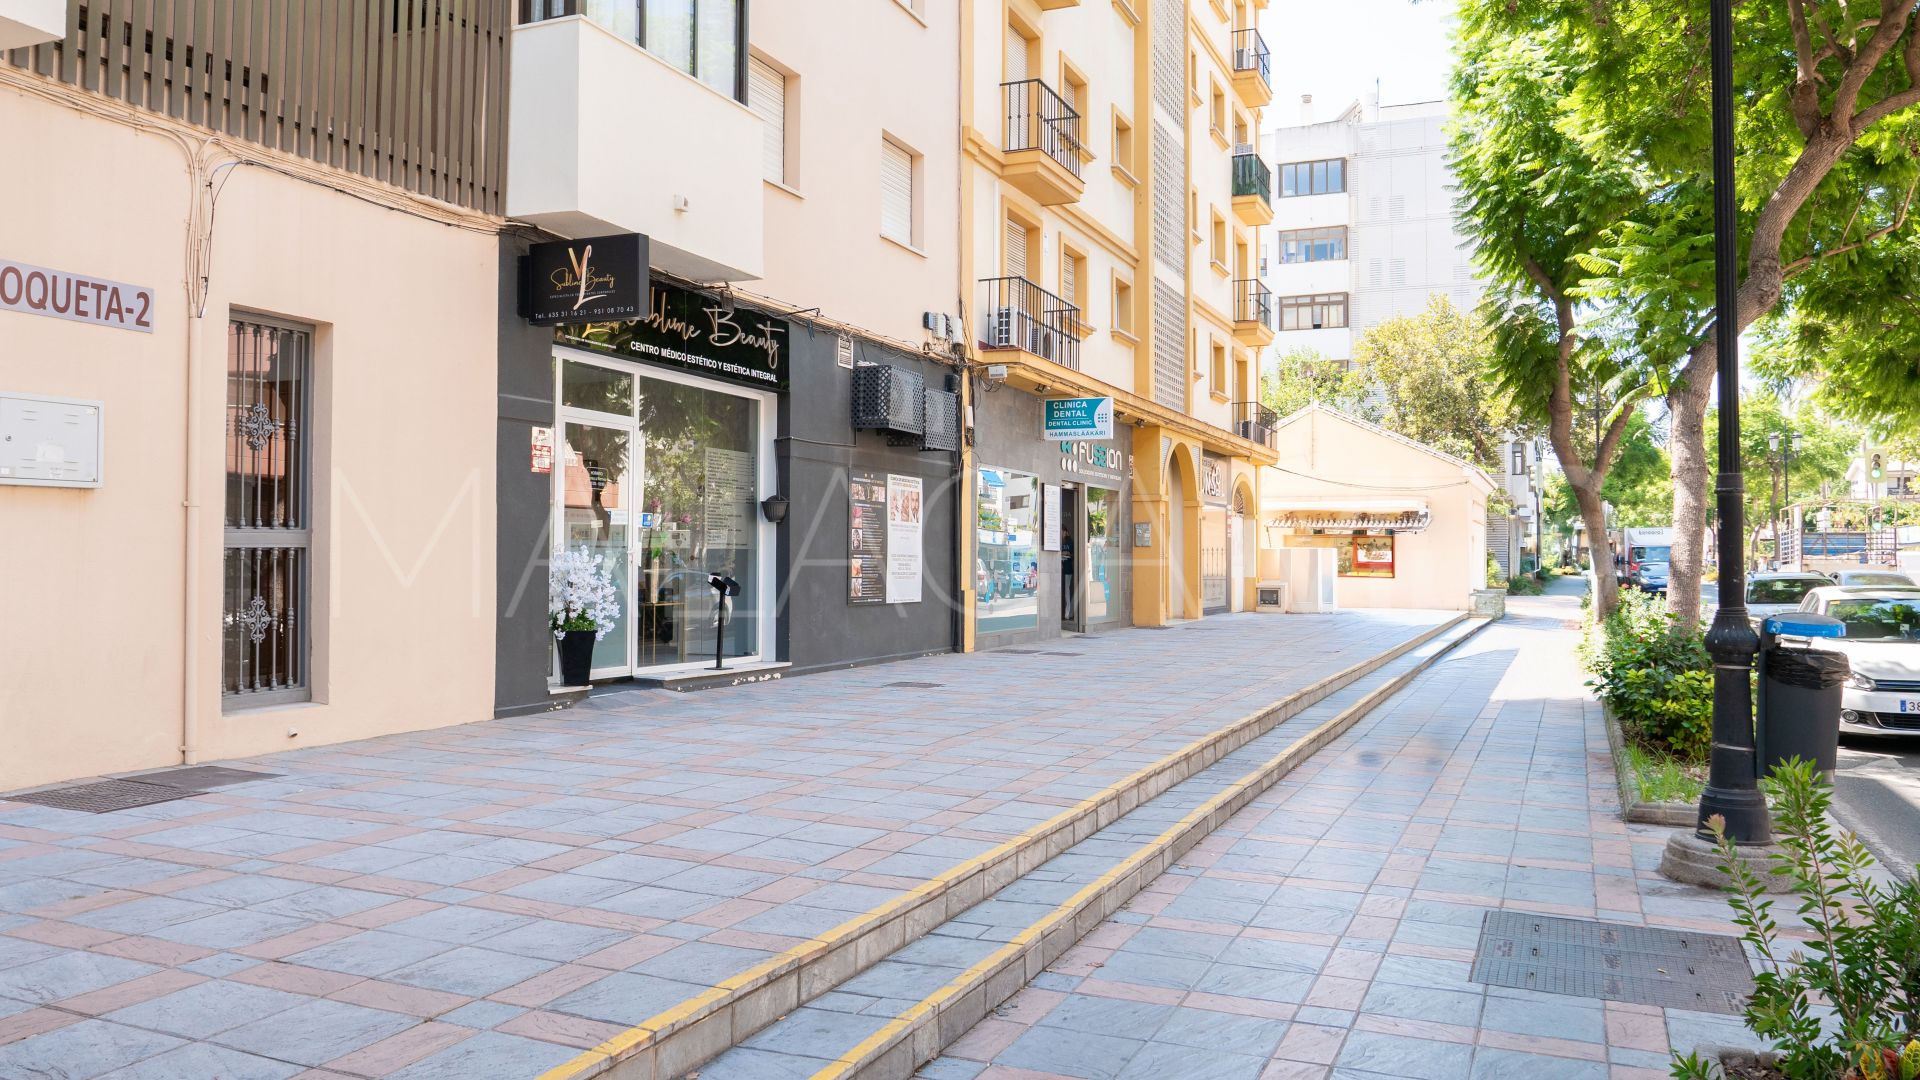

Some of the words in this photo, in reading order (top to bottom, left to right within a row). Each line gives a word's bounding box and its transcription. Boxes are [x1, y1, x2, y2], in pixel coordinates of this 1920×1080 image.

[584, 266, 616, 292] Beauty
[702, 305, 785, 369] Beauty
[630, 340, 660, 356] CENTRO
[660, 347, 687, 362] MÉDICO
[686, 354, 718, 369] ESTÉTICO
[717, 361, 724, 370] Y
[723, 362, 750, 377] ESTÉTICA
[750, 369, 778, 382] INTEGRAL
[1053, 401, 1088, 409] CLINICA
[1053, 410, 1088, 418] DENTAL
